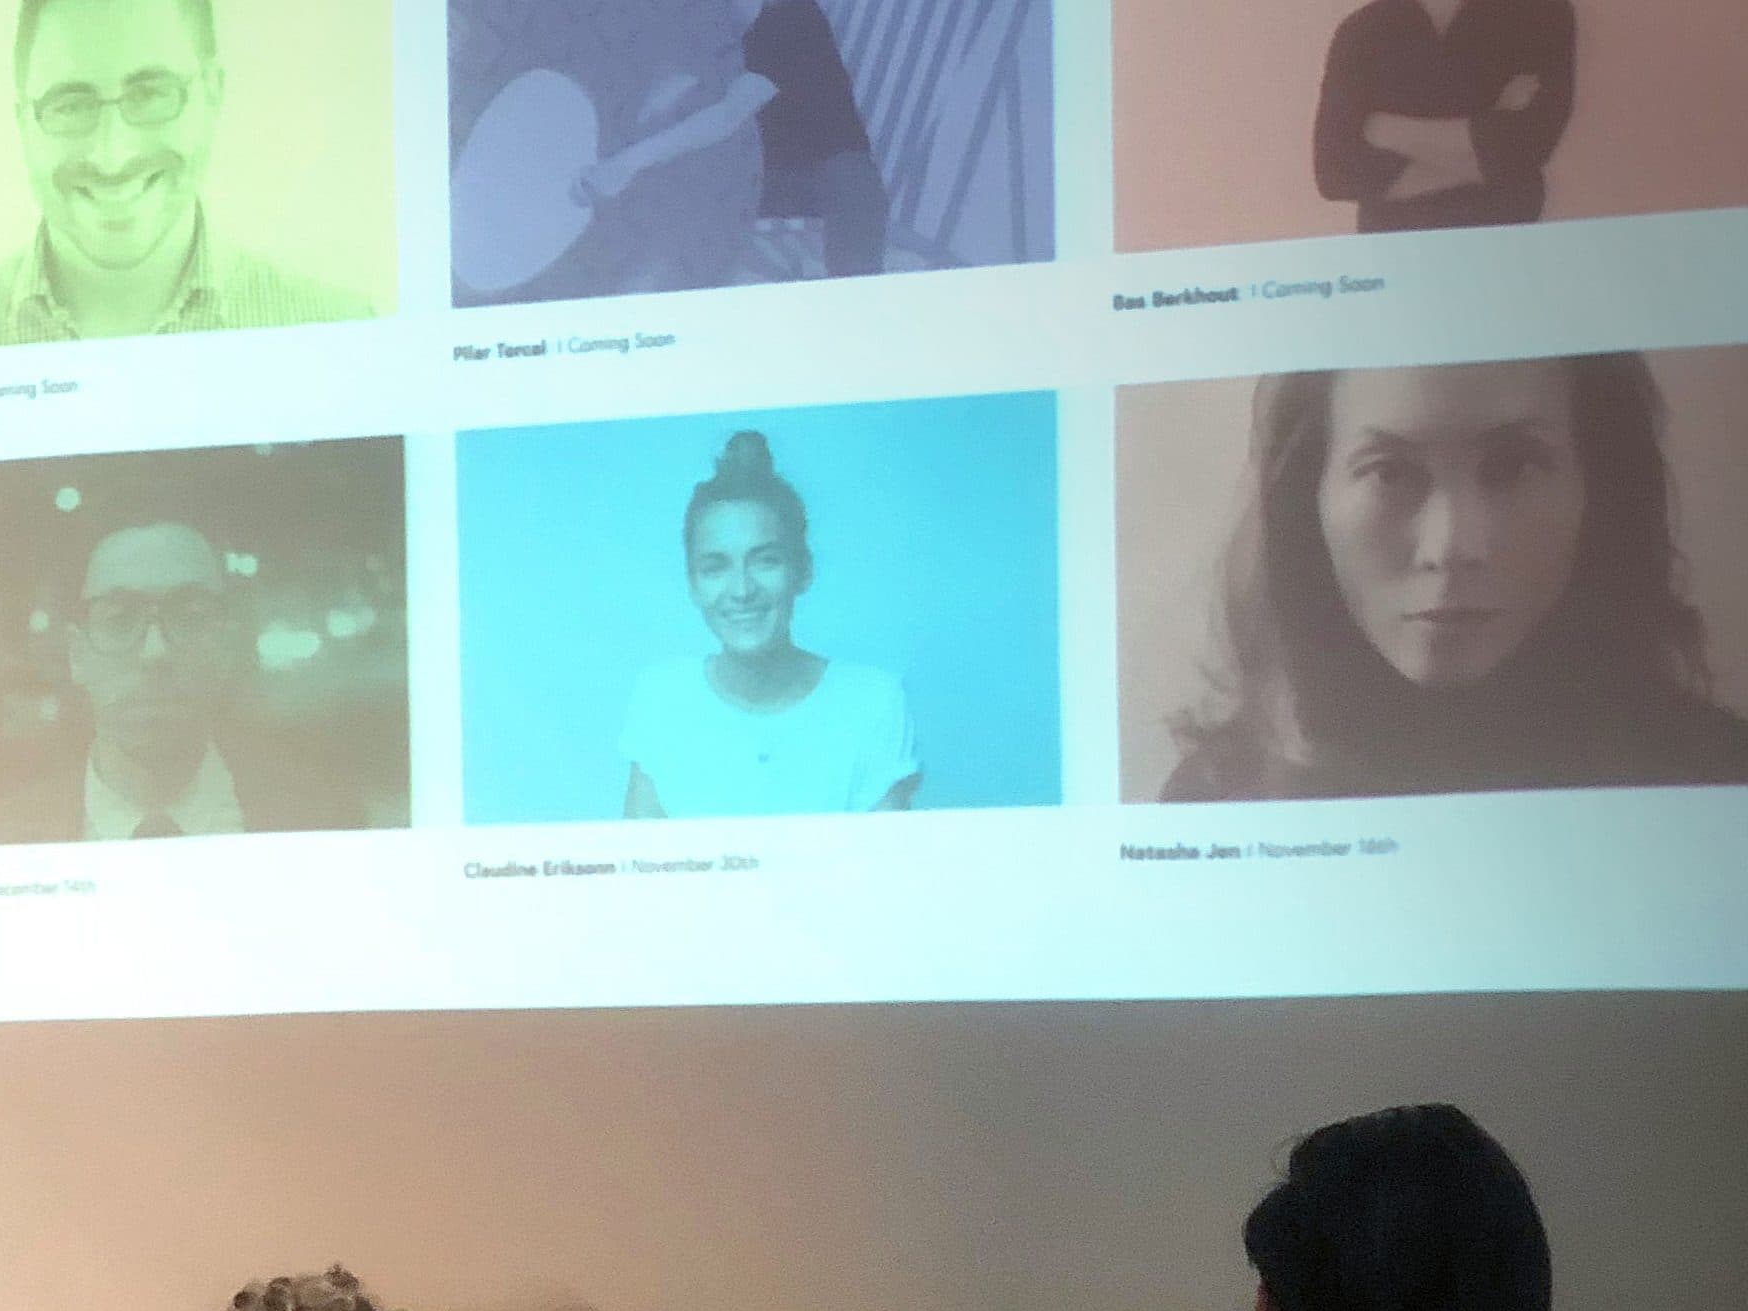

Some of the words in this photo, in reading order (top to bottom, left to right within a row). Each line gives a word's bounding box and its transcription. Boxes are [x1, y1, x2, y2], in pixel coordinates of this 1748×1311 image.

[1261, 280, 1332, 299] Coming
[1339, 275, 1385, 293] Soon
[568, 336, 629, 354] Coming
[635, 332, 676, 348] Soon
[41, 379, 78, 394] Soon
[1258, 839, 1351, 858] November
[463, 860, 537, 878] Claudine
[632, 858, 714, 873] November
